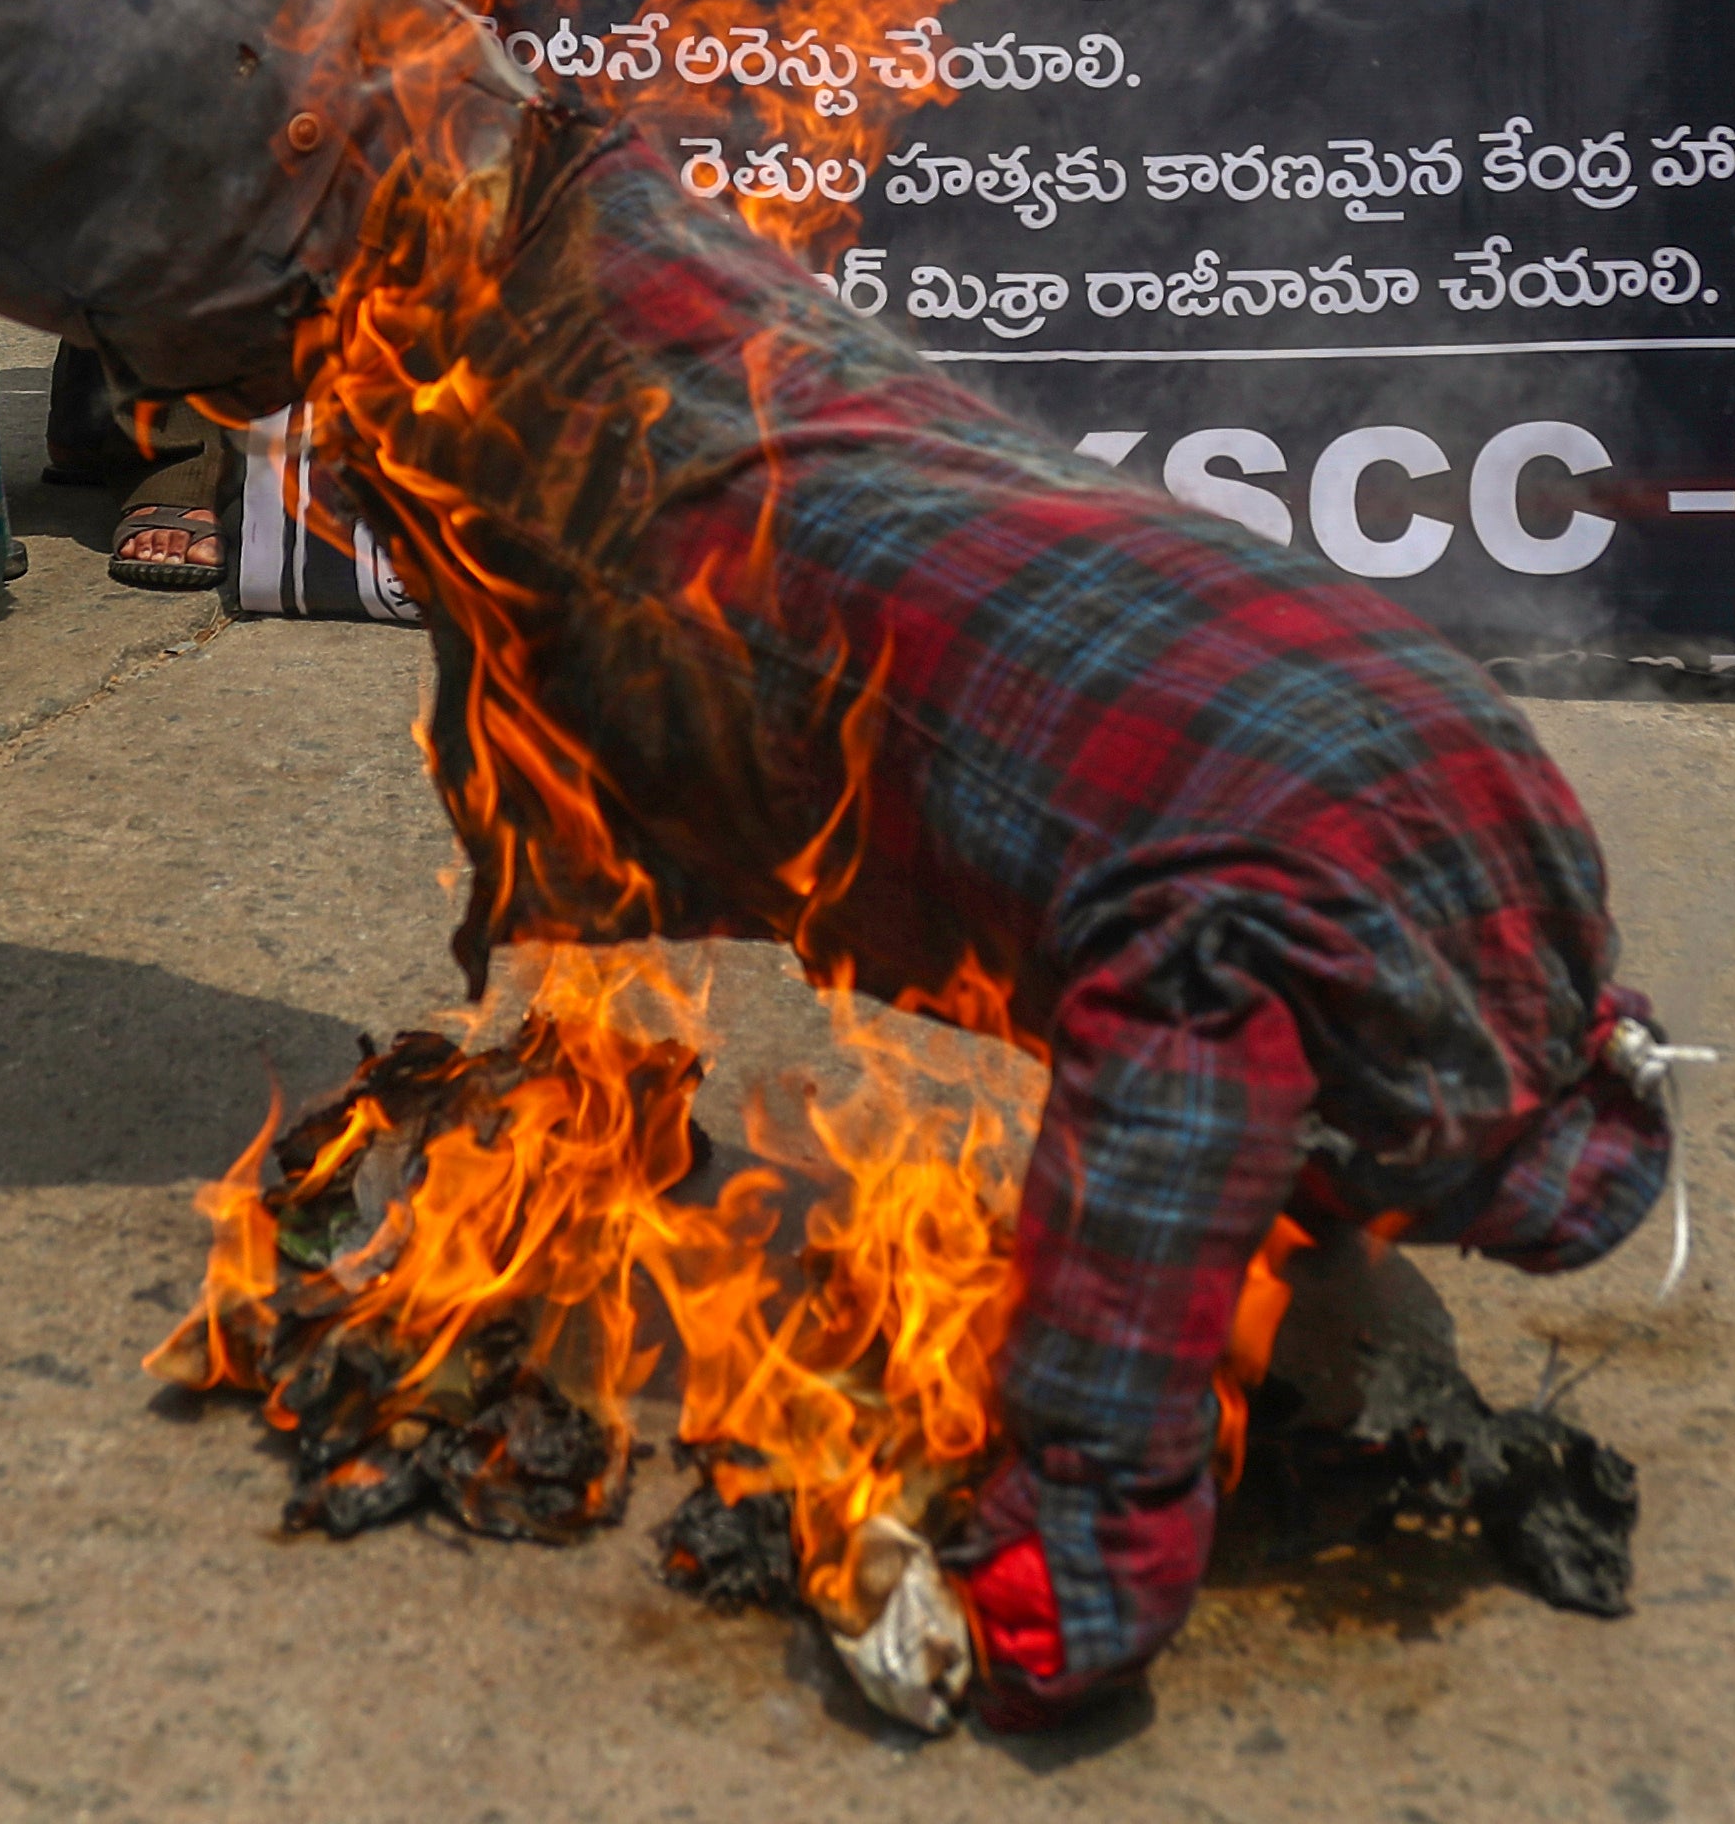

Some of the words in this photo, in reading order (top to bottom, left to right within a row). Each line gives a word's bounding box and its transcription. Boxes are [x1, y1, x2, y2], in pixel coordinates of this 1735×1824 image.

[675, 26, 857, 118] అరెస్టు
[869, 16, 1142, 91] చేయాలి.
[885, 142, 1128, 230] హత్యకు
[1144, 138, 1463, 224] కారణమైన
[1480, 115, 1641, 210] కేంద్ర
[907, 262, 1069, 339] మిశ్రా
[1086, 250, 1421, 319] రాజీనామా
[1438, 235, 1721, 312] చేయాలి.
